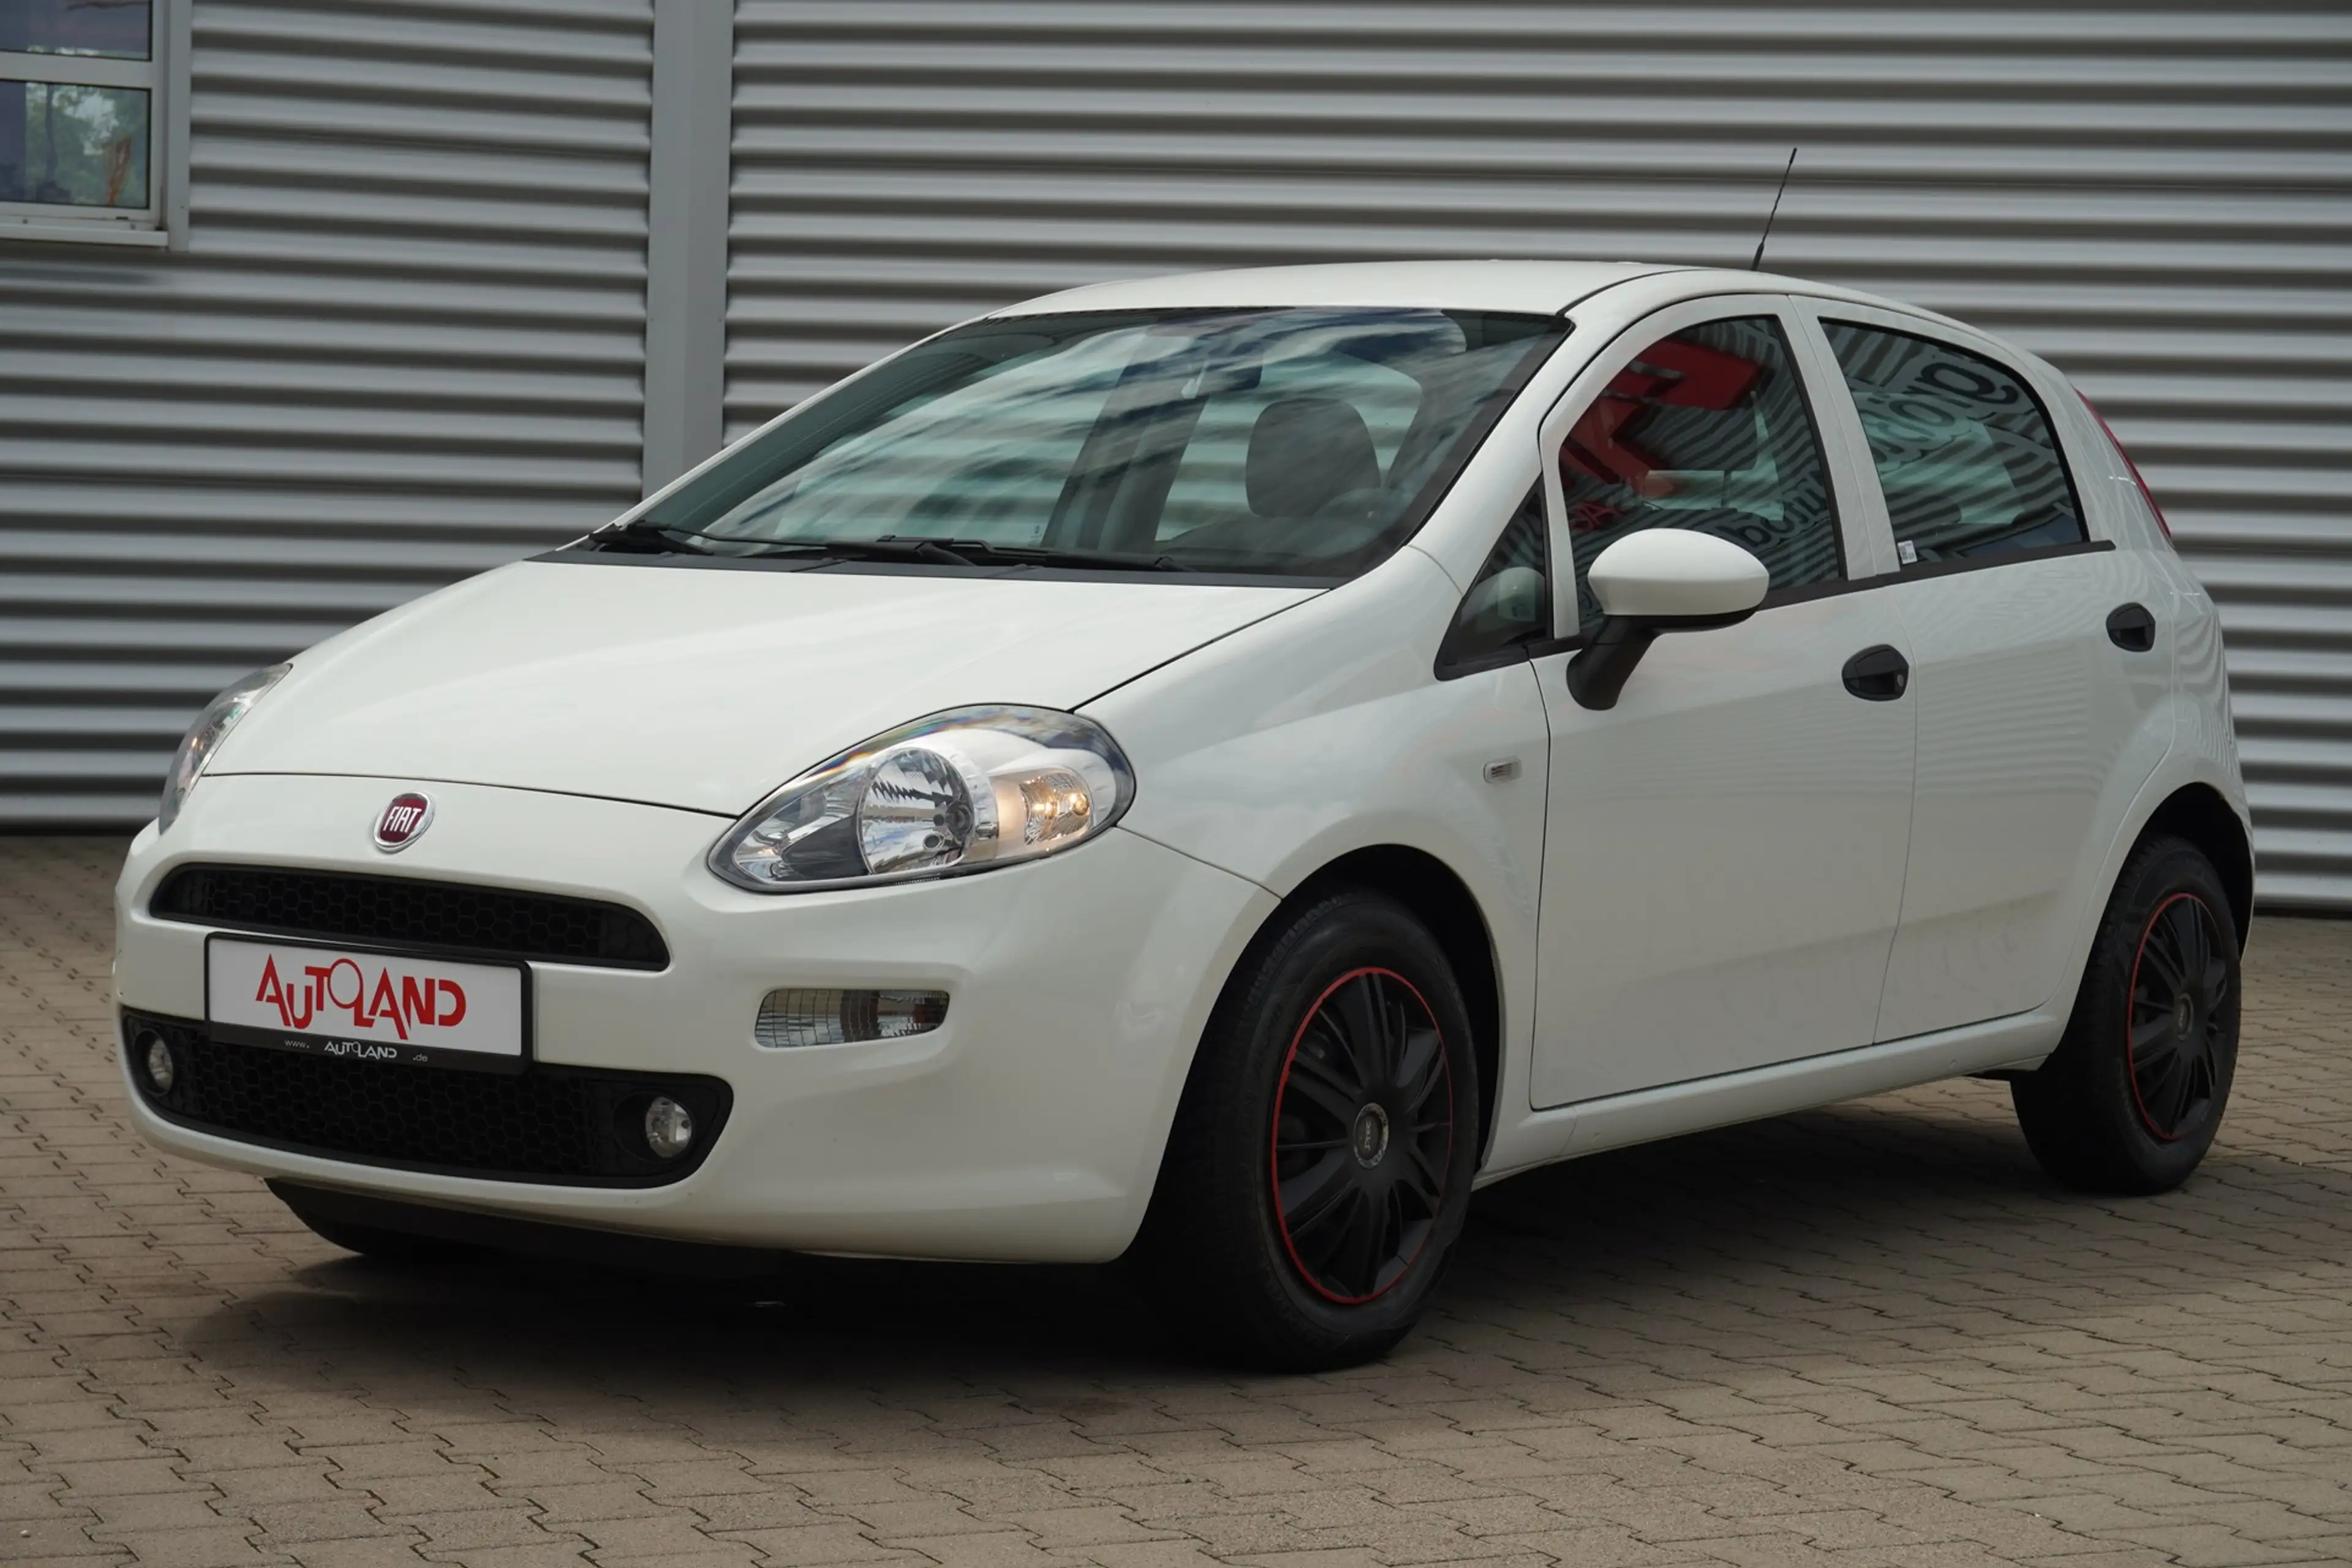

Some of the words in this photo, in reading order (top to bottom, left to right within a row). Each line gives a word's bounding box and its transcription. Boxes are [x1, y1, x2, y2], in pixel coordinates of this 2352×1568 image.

[383, 806, 421, 834] FIAT
[255, 953, 467, 1041] AUTOLAND
[284, 1040, 310, 1049] www.
[324, 1041, 398, 1060] AUTOLAND
